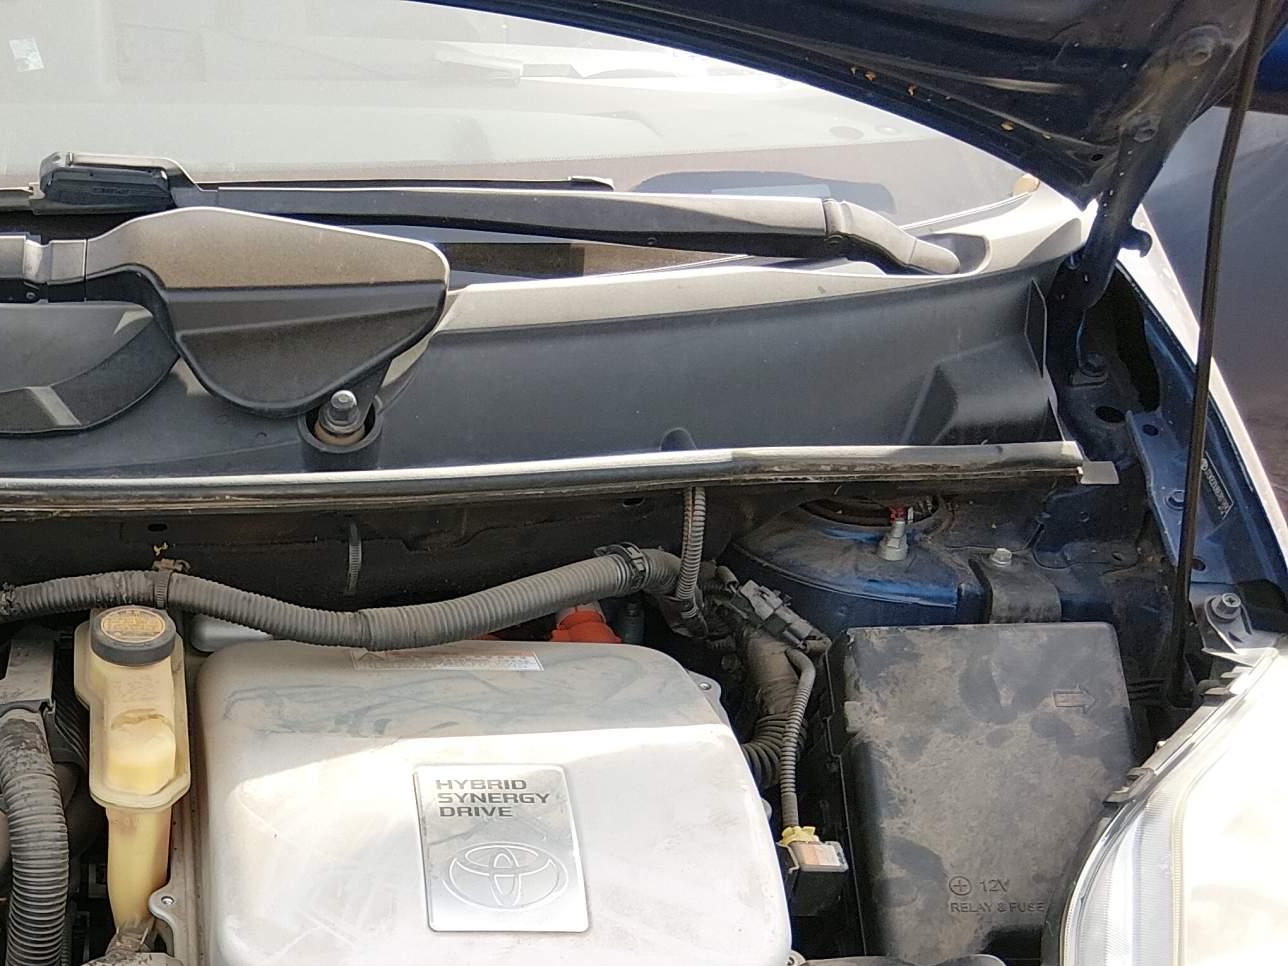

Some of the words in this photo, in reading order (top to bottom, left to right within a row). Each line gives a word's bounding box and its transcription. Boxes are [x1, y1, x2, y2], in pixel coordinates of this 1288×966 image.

[436, 779, 527, 790] HYBRID
[438, 793, 550, 804] SYNERGY
[440, 806, 513, 817] DRIVE
[978, 879, 1010, 893] 12V
[950, 902, 993, 913] RELAY
[996, 902, 1008, 913] &
[1009, 902, 1046, 913] FUSE
